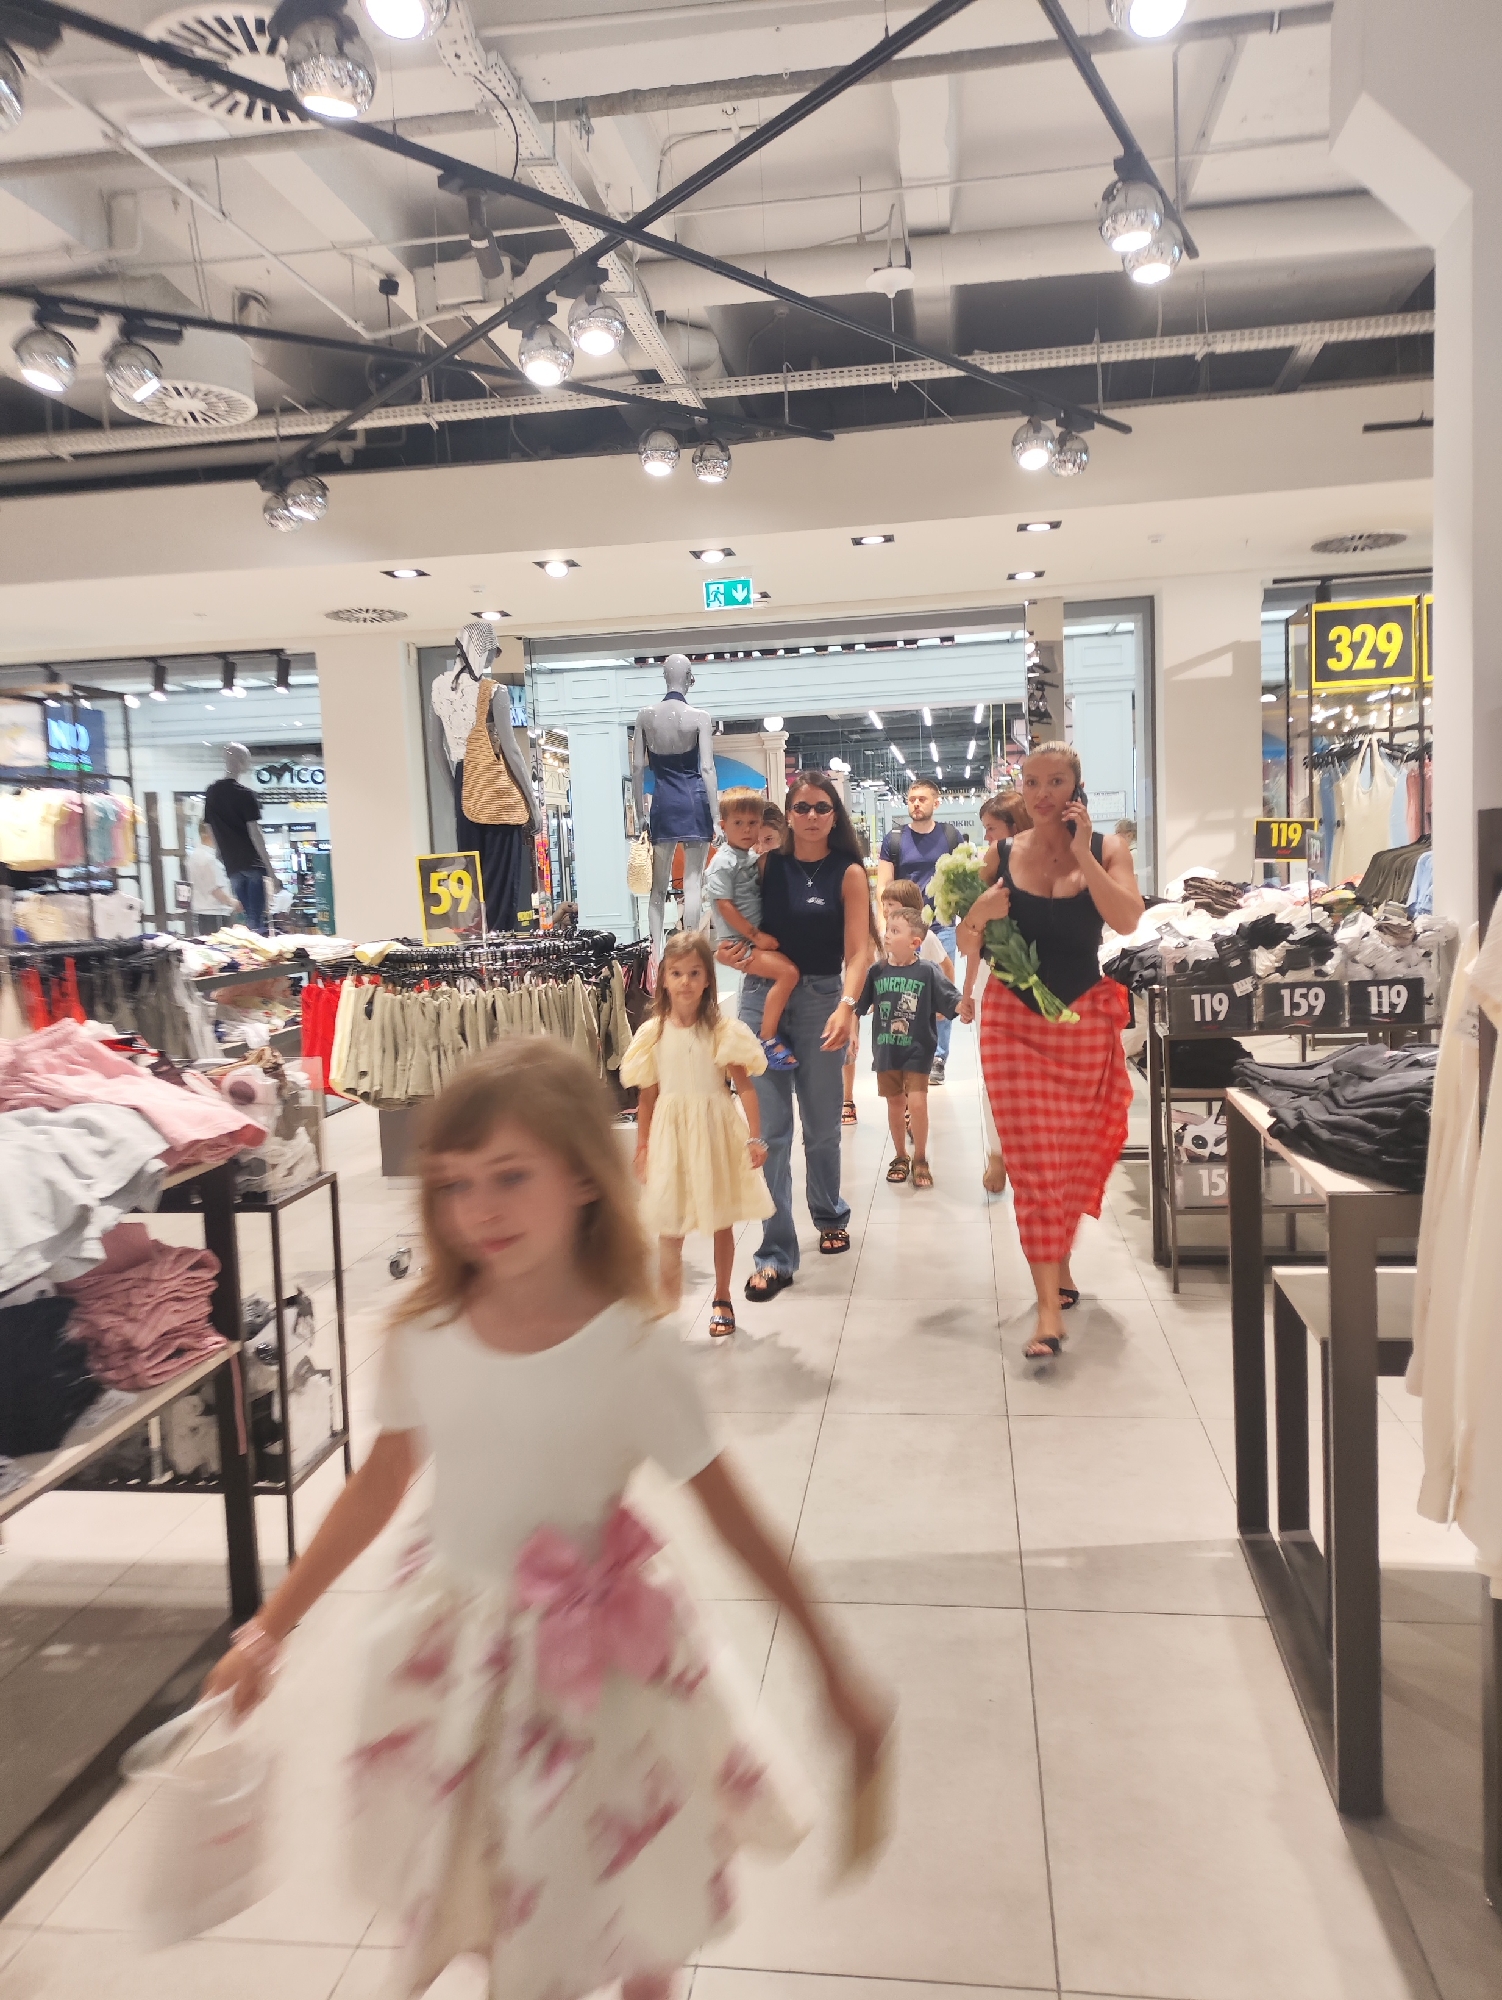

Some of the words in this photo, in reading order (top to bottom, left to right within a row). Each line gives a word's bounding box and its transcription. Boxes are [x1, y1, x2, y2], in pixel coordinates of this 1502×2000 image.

[1326, 622, 1404, 672] 329
[1270, 822, 1303, 848] 119
[429, 869, 473, 915] 59
[1190, 992, 1230, 1023] 119
[1280, 986, 1326, 1017] 159
[1366, 984, 1409, 1015] 119
[1198, 1168, 1229, 1197] 15
